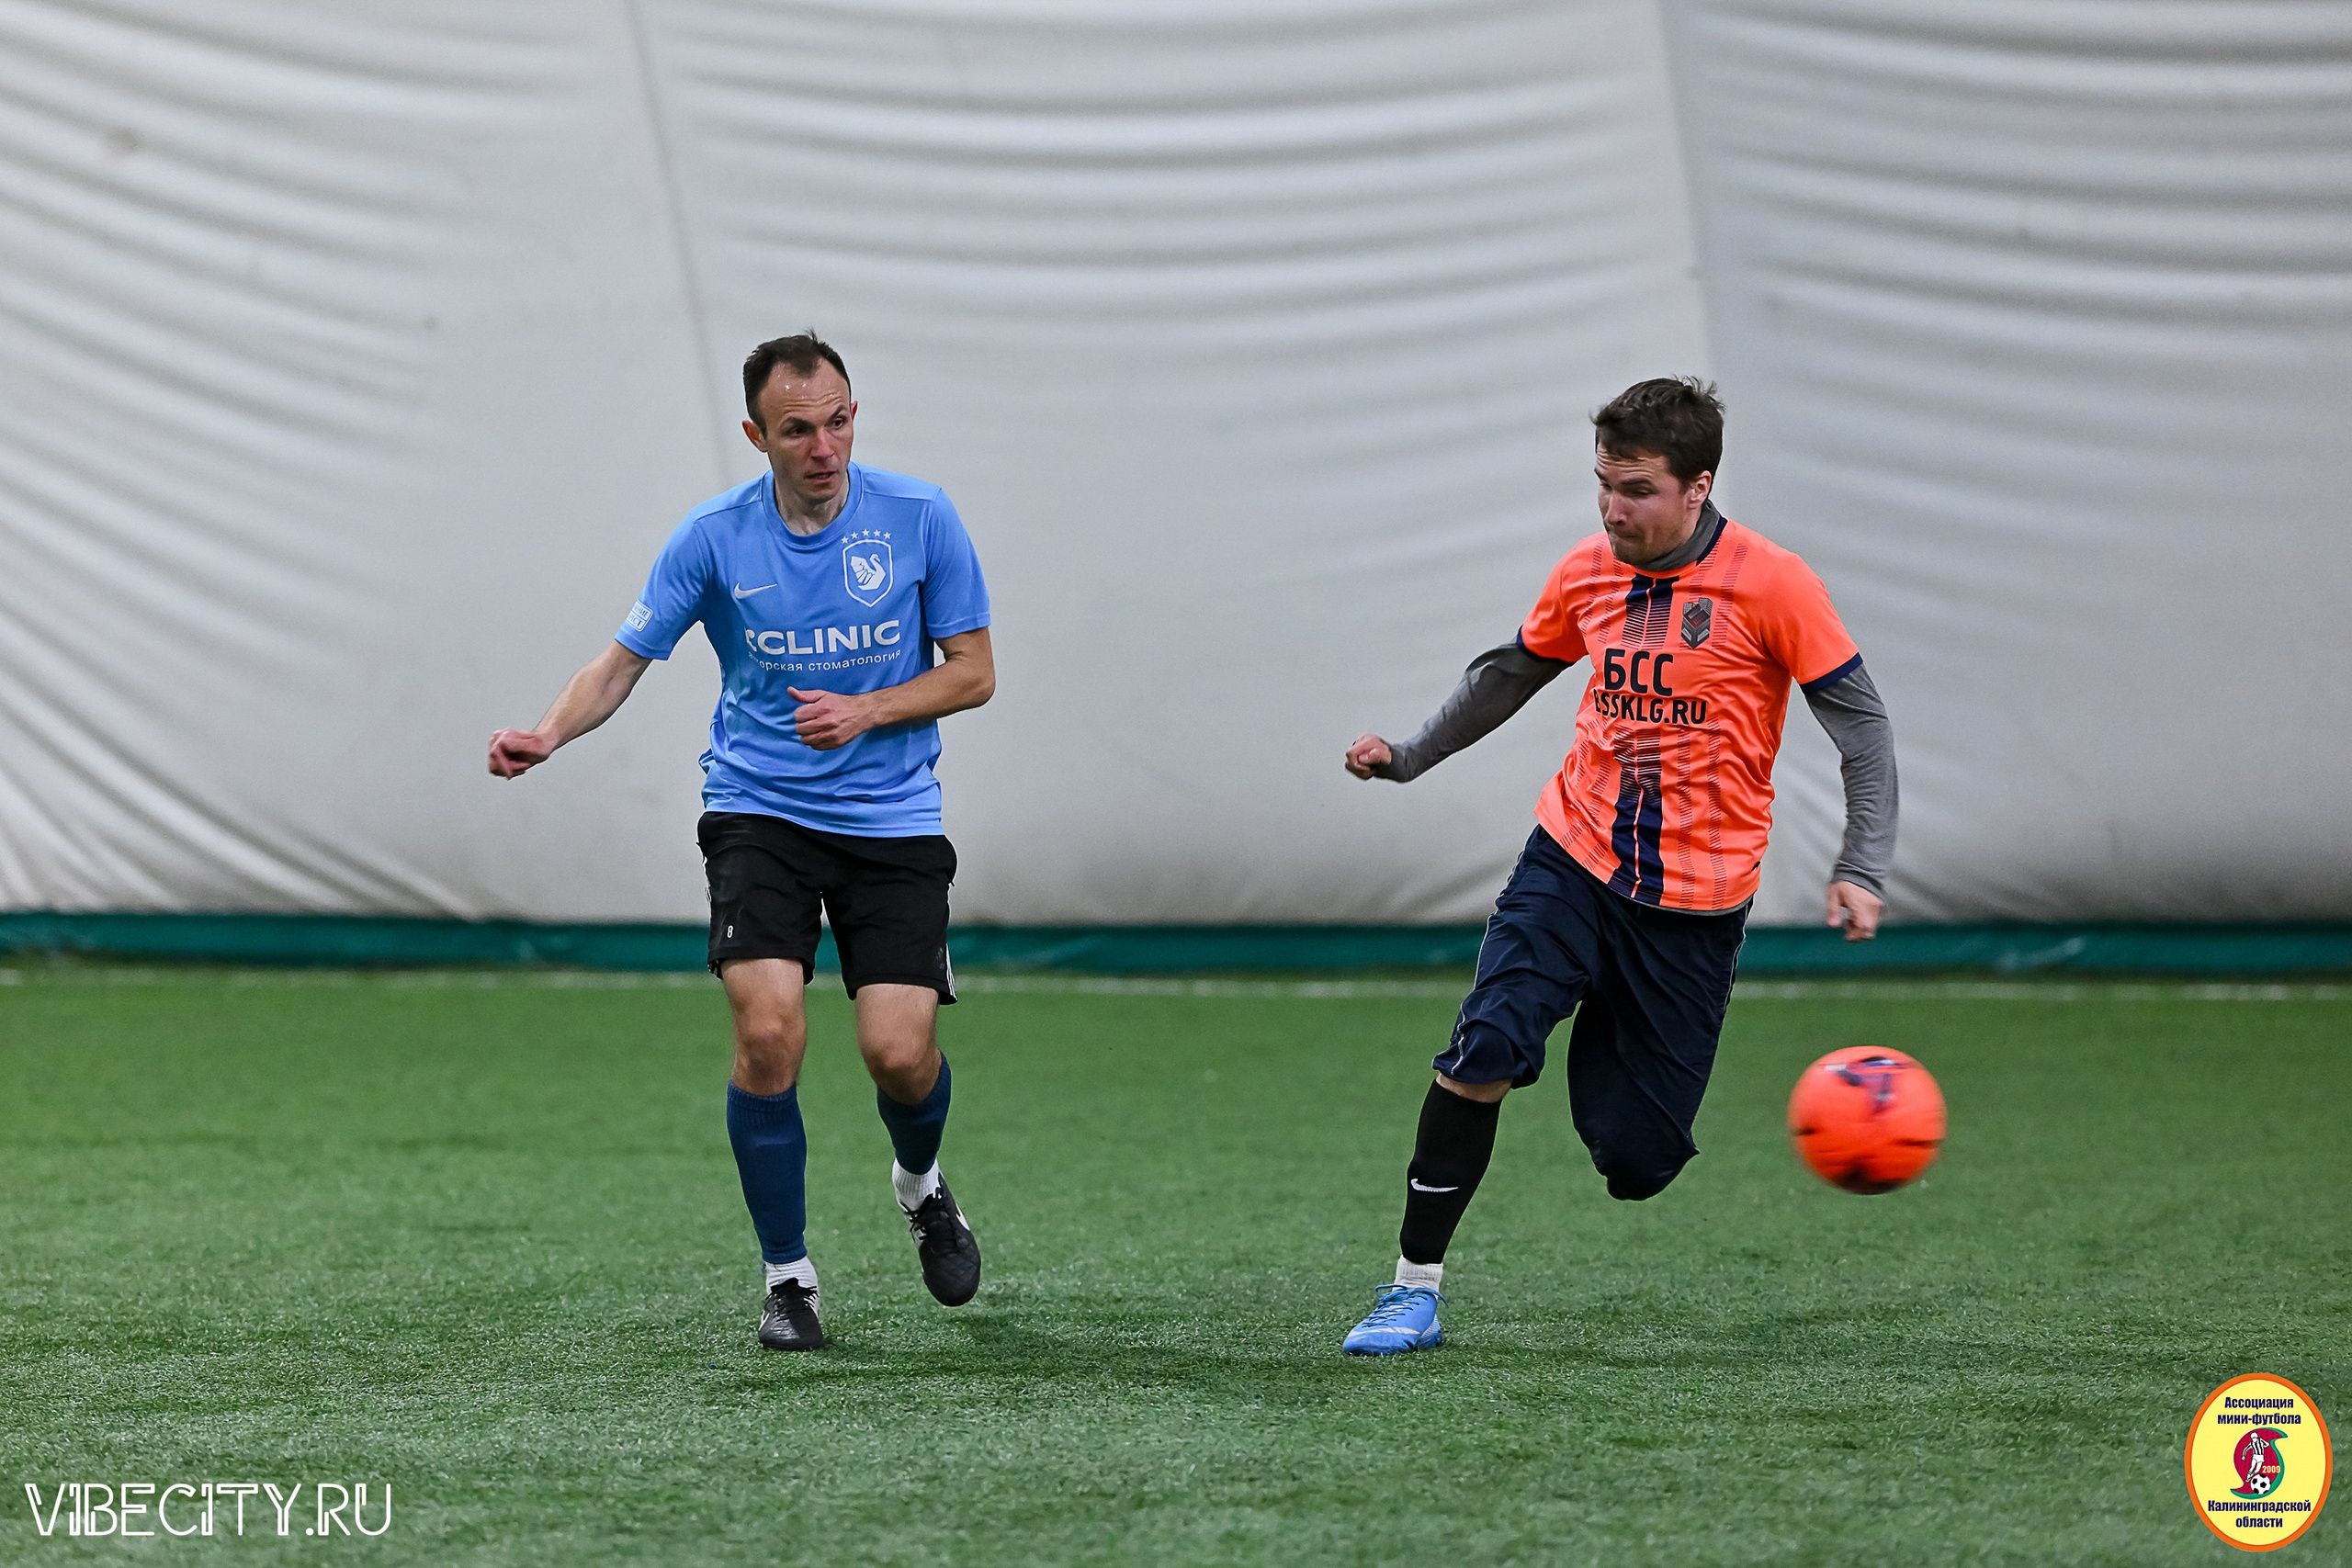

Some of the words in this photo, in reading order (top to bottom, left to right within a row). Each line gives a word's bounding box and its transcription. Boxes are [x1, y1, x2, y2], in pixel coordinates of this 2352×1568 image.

[748, 651, 803, 671] орская
[808, 649, 901, 671] стоматология
[1603, 648, 1674, 696] БСС
[727, 925, 734, 938] 8
